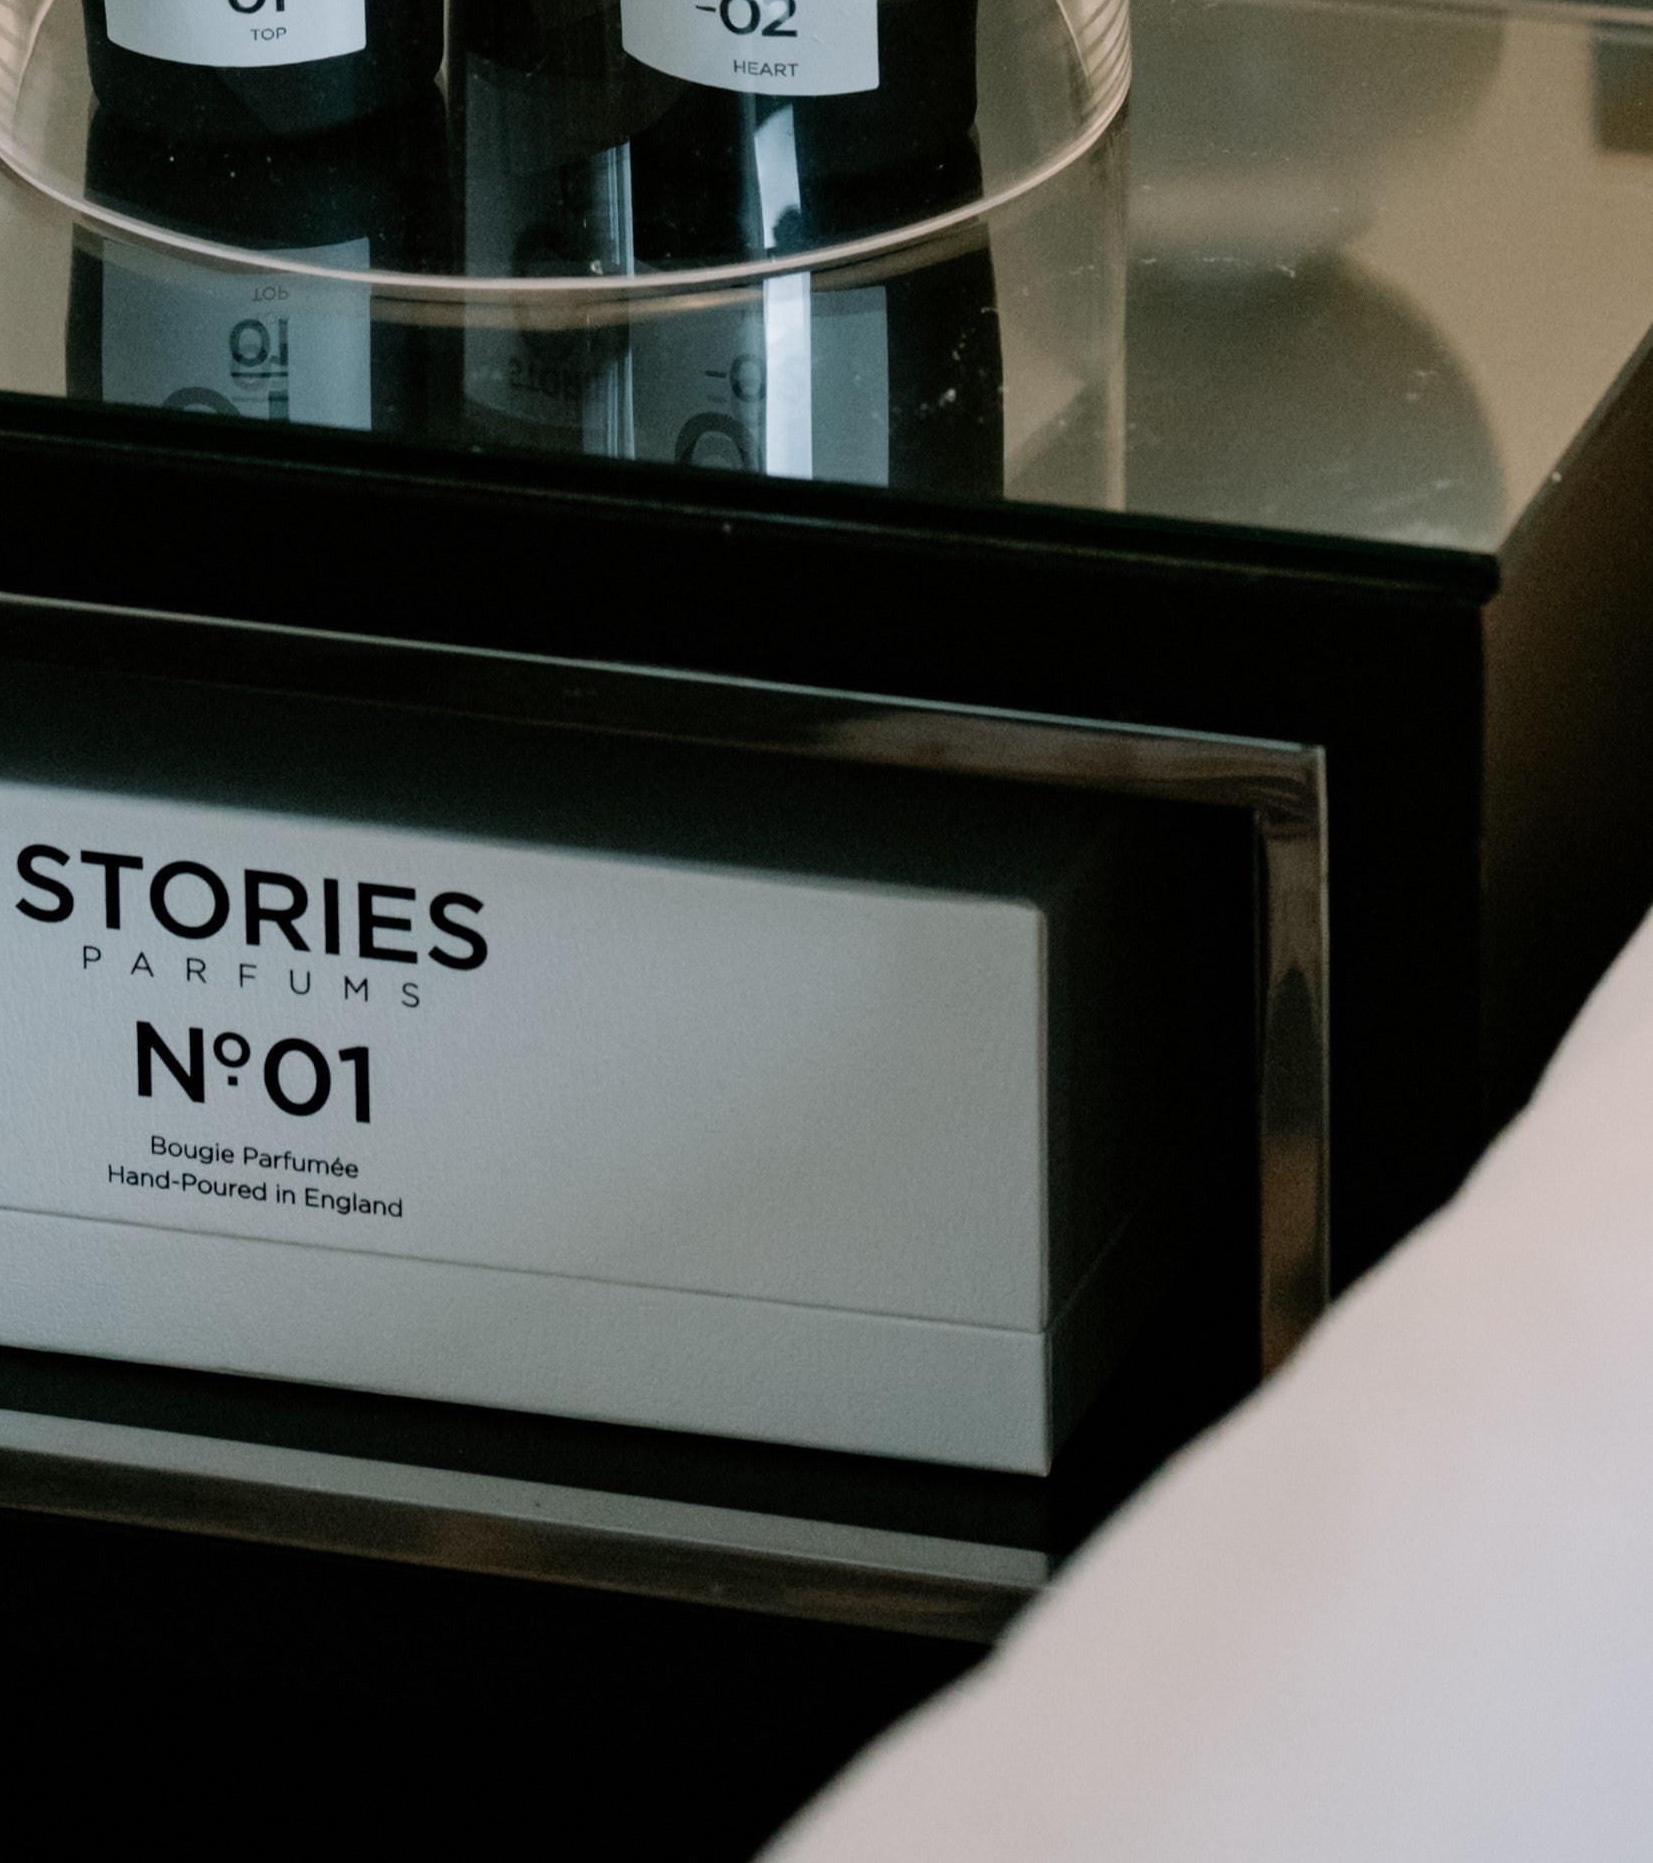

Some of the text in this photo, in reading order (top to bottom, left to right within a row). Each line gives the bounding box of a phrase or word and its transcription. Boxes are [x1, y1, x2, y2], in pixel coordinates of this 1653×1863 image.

[250, 26, 288, 42] TOP
[732, 58, 799, 78] HEART
[15, 843, 488, 971] STORIES
[81, 944, 422, 1009] PARFUMS
[150, 1134, 360, 1180] Bougie Parfumée
[107, 1163, 404, 1218] Hand-Poured in England
